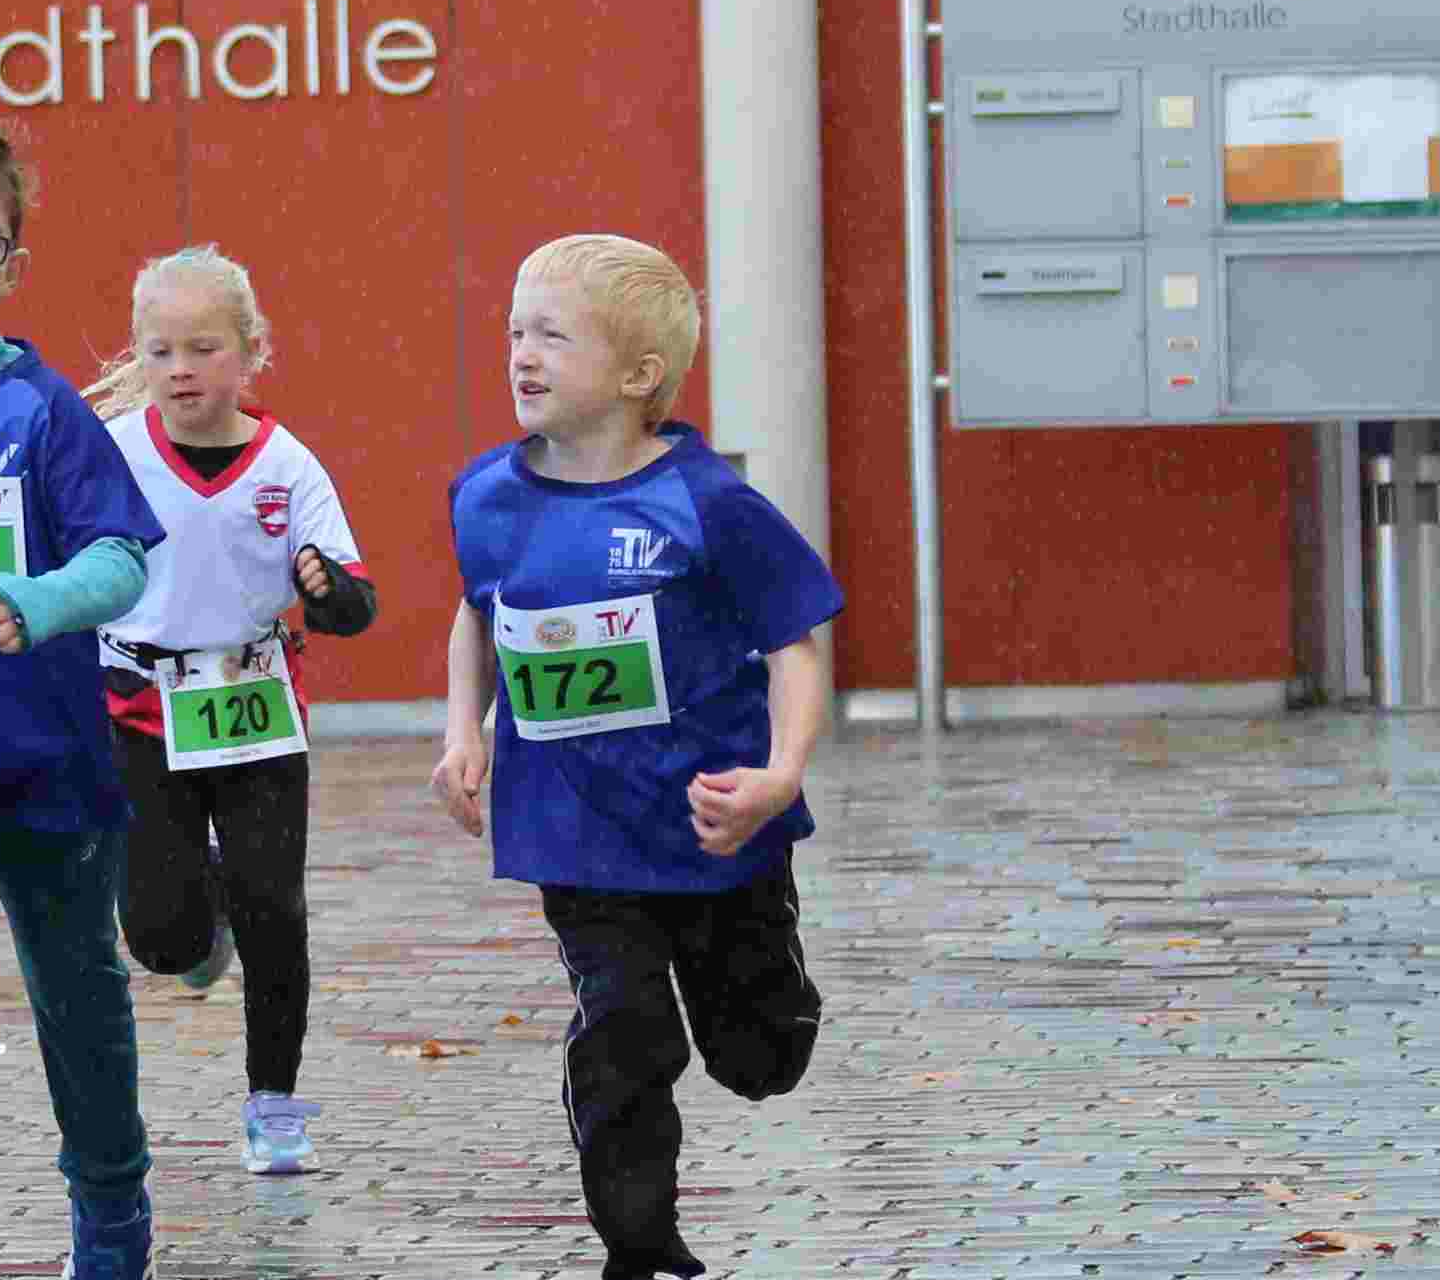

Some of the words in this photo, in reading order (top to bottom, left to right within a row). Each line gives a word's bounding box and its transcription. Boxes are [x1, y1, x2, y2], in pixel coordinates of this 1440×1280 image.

[1121, 1, 1288, 33] Stadthalle
[594, 607, 641, 637] TV
[513, 658, 622, 712] 172
[197, 691, 270, 740] 120
